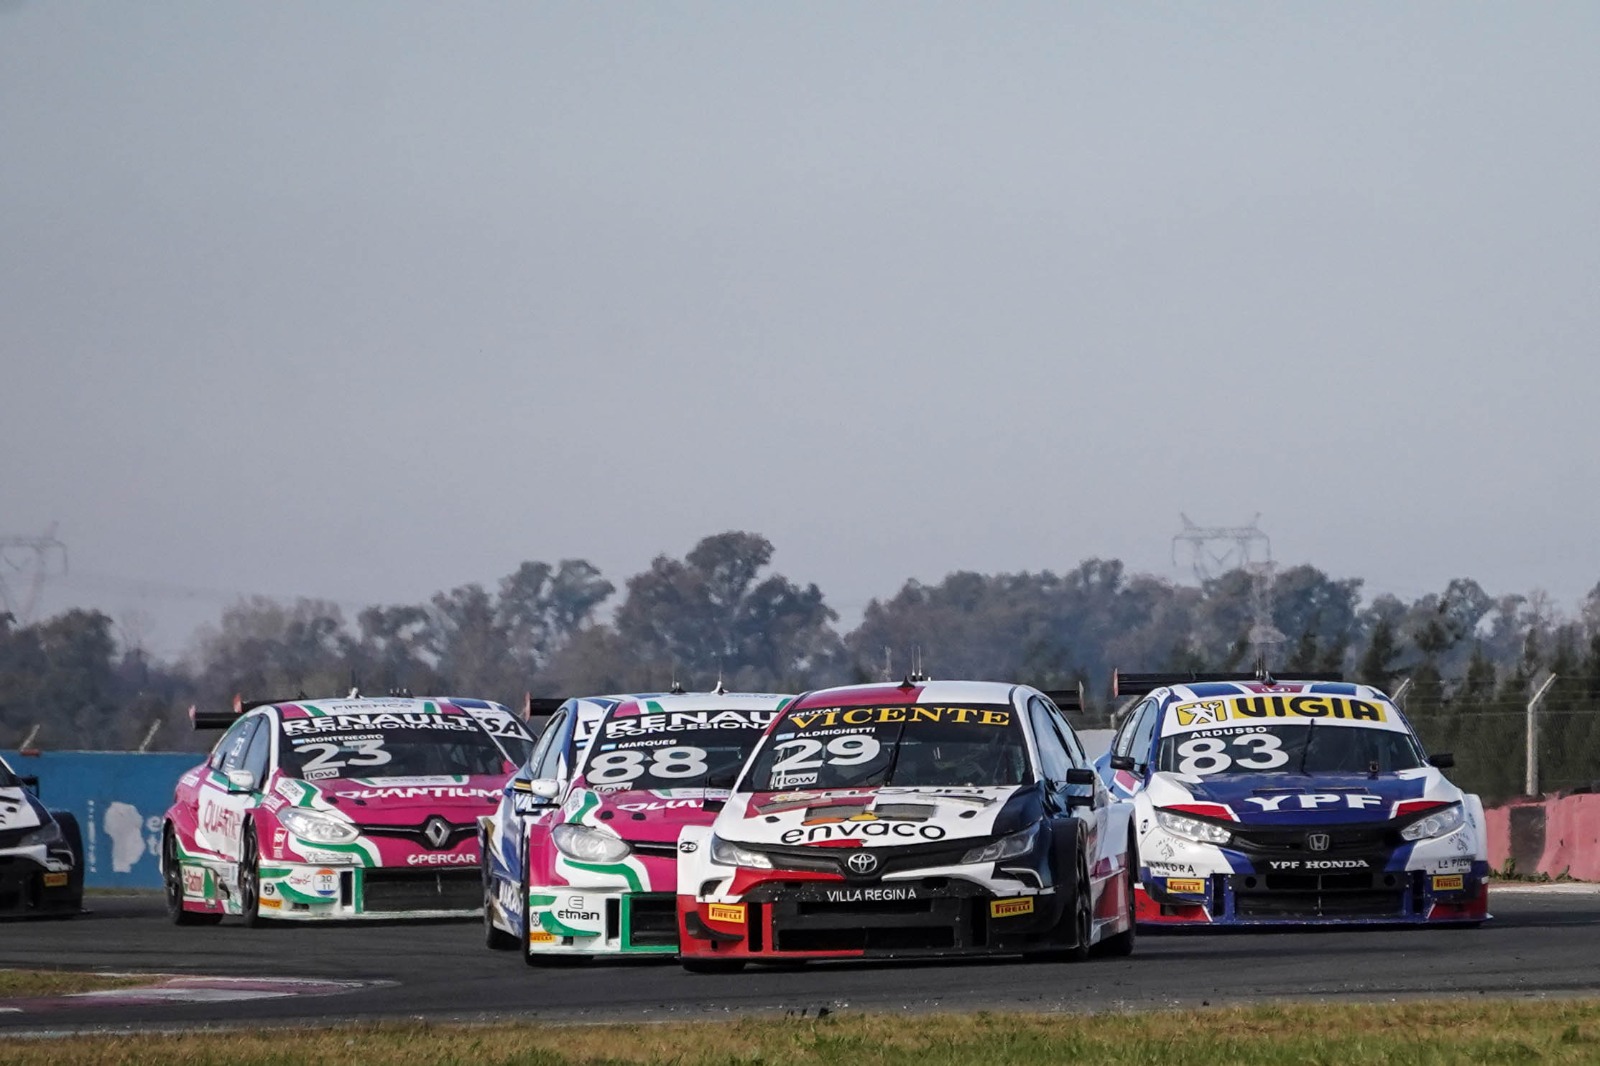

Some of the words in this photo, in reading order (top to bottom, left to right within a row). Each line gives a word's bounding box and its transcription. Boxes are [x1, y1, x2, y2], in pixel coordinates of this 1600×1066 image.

[282, 714, 474, 732] RENAULT
[790, 707, 1009, 728] VICENTE
[286, 722, 478, 737] CONCESIONARIOS
[796, 727, 876, 738] ALDRIGHETTI
[1190, 726, 1267, 739] ARDUSSO
[304, 734, 384, 744] MONTENEGRO
[618, 739, 677, 750] MARQUES
[293, 740, 392, 772] 23
[772, 734, 881, 772] 29
[1177, 733, 1289, 775] 83
[586, 746, 709, 785] 88
[304, 770, 338, 780] flow
[776, 775, 816, 787] flow
[335, 787, 503, 799] QUANTIUM
[1244, 794, 1383, 811] YPF
[781, 822, 946, 844] envaco
[680, 843, 697, 852] 29
[1270, 861, 1300, 869] YPF
[1305, 860, 1370, 869] HONDA
[1169, 881, 1201, 891] PIRELLI
[827, 890, 863, 902] VILLA
[865, 888, 917, 901] REGINA
[712, 907, 742, 919] PIRELLI
[994, 901, 1031, 914] PIRELLI
[557, 909, 600, 921] etman
